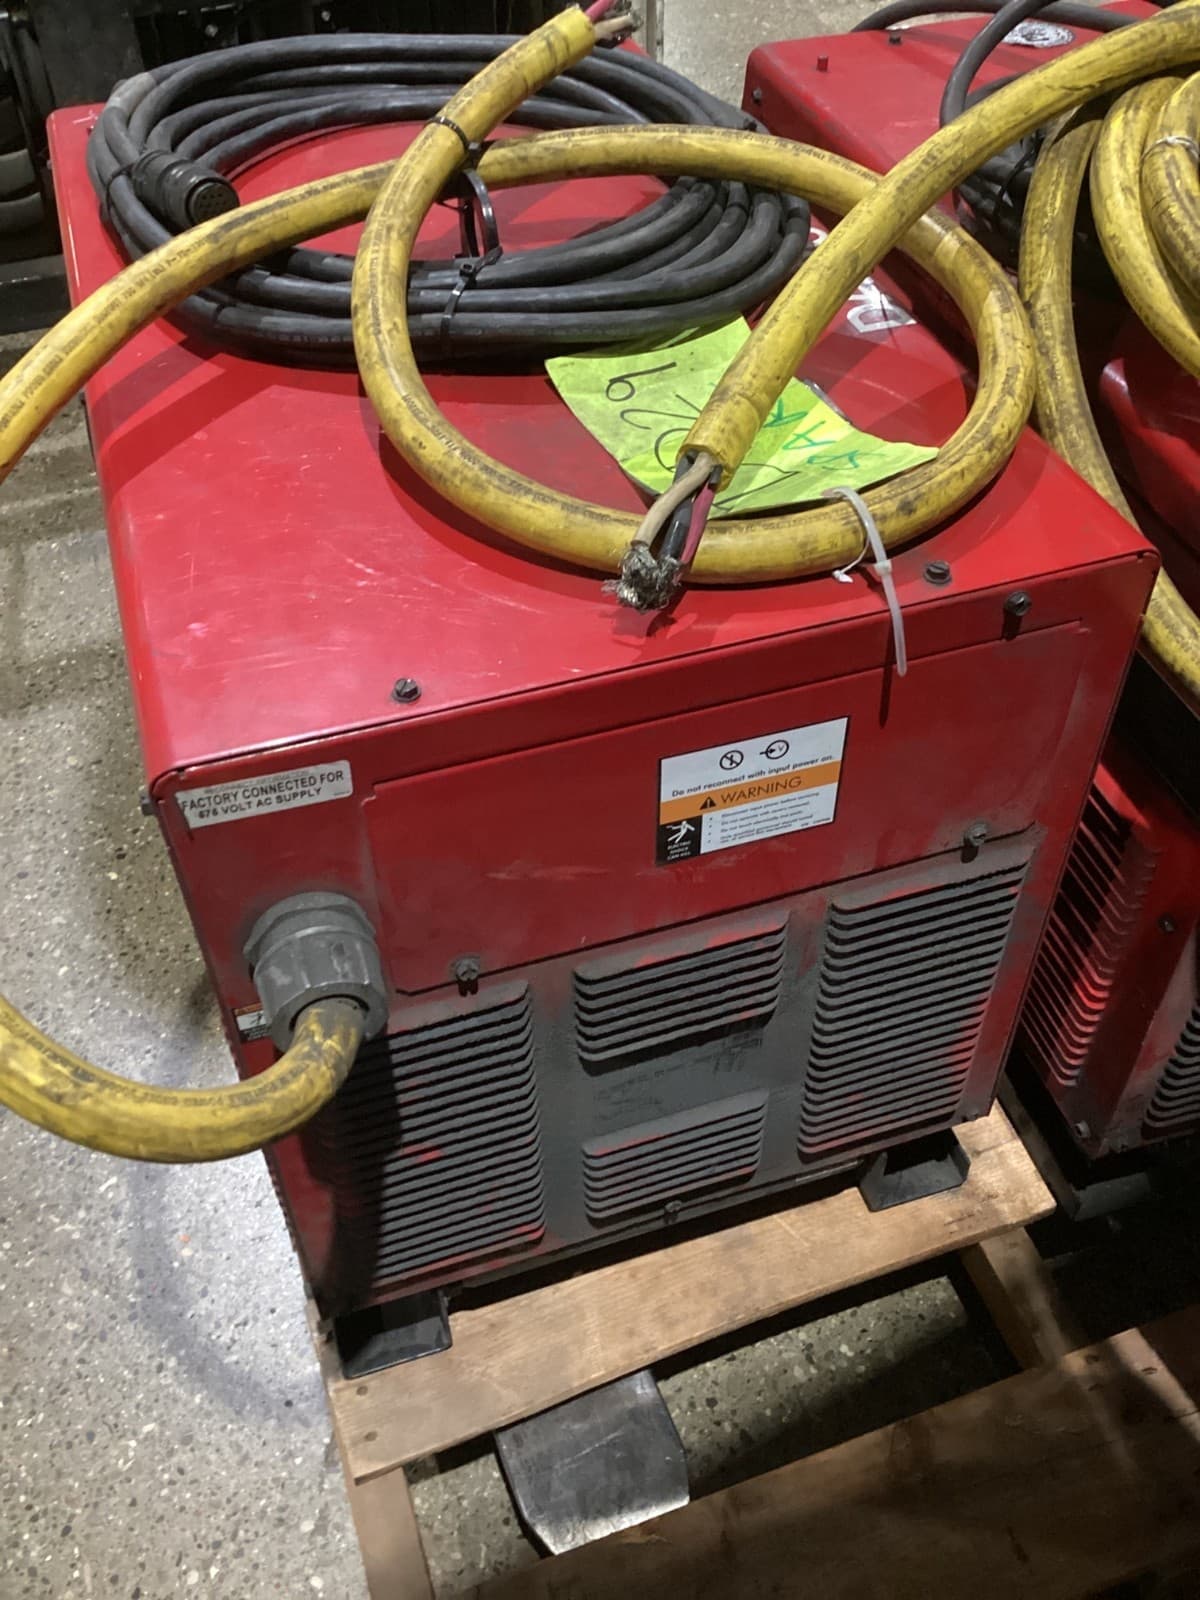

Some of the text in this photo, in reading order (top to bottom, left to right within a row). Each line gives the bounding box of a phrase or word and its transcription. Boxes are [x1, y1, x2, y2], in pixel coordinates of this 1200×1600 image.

[182, 792, 239, 811] FACTORY
[242, 775, 317, 800] CONNECTED
[320, 770, 344, 784] FOR
[687, 785, 701, 793] not
[703, 775, 745, 790] reconnect
[747, 769, 766, 779] with
[768, 764, 790, 774] input
[792, 758, 818, 770] power
[720, 776, 802, 803] WARNING
[221, 799, 253, 814] VOLT
[256, 796, 273, 808] AC
[276, 787, 322, 804] SUPPLY
